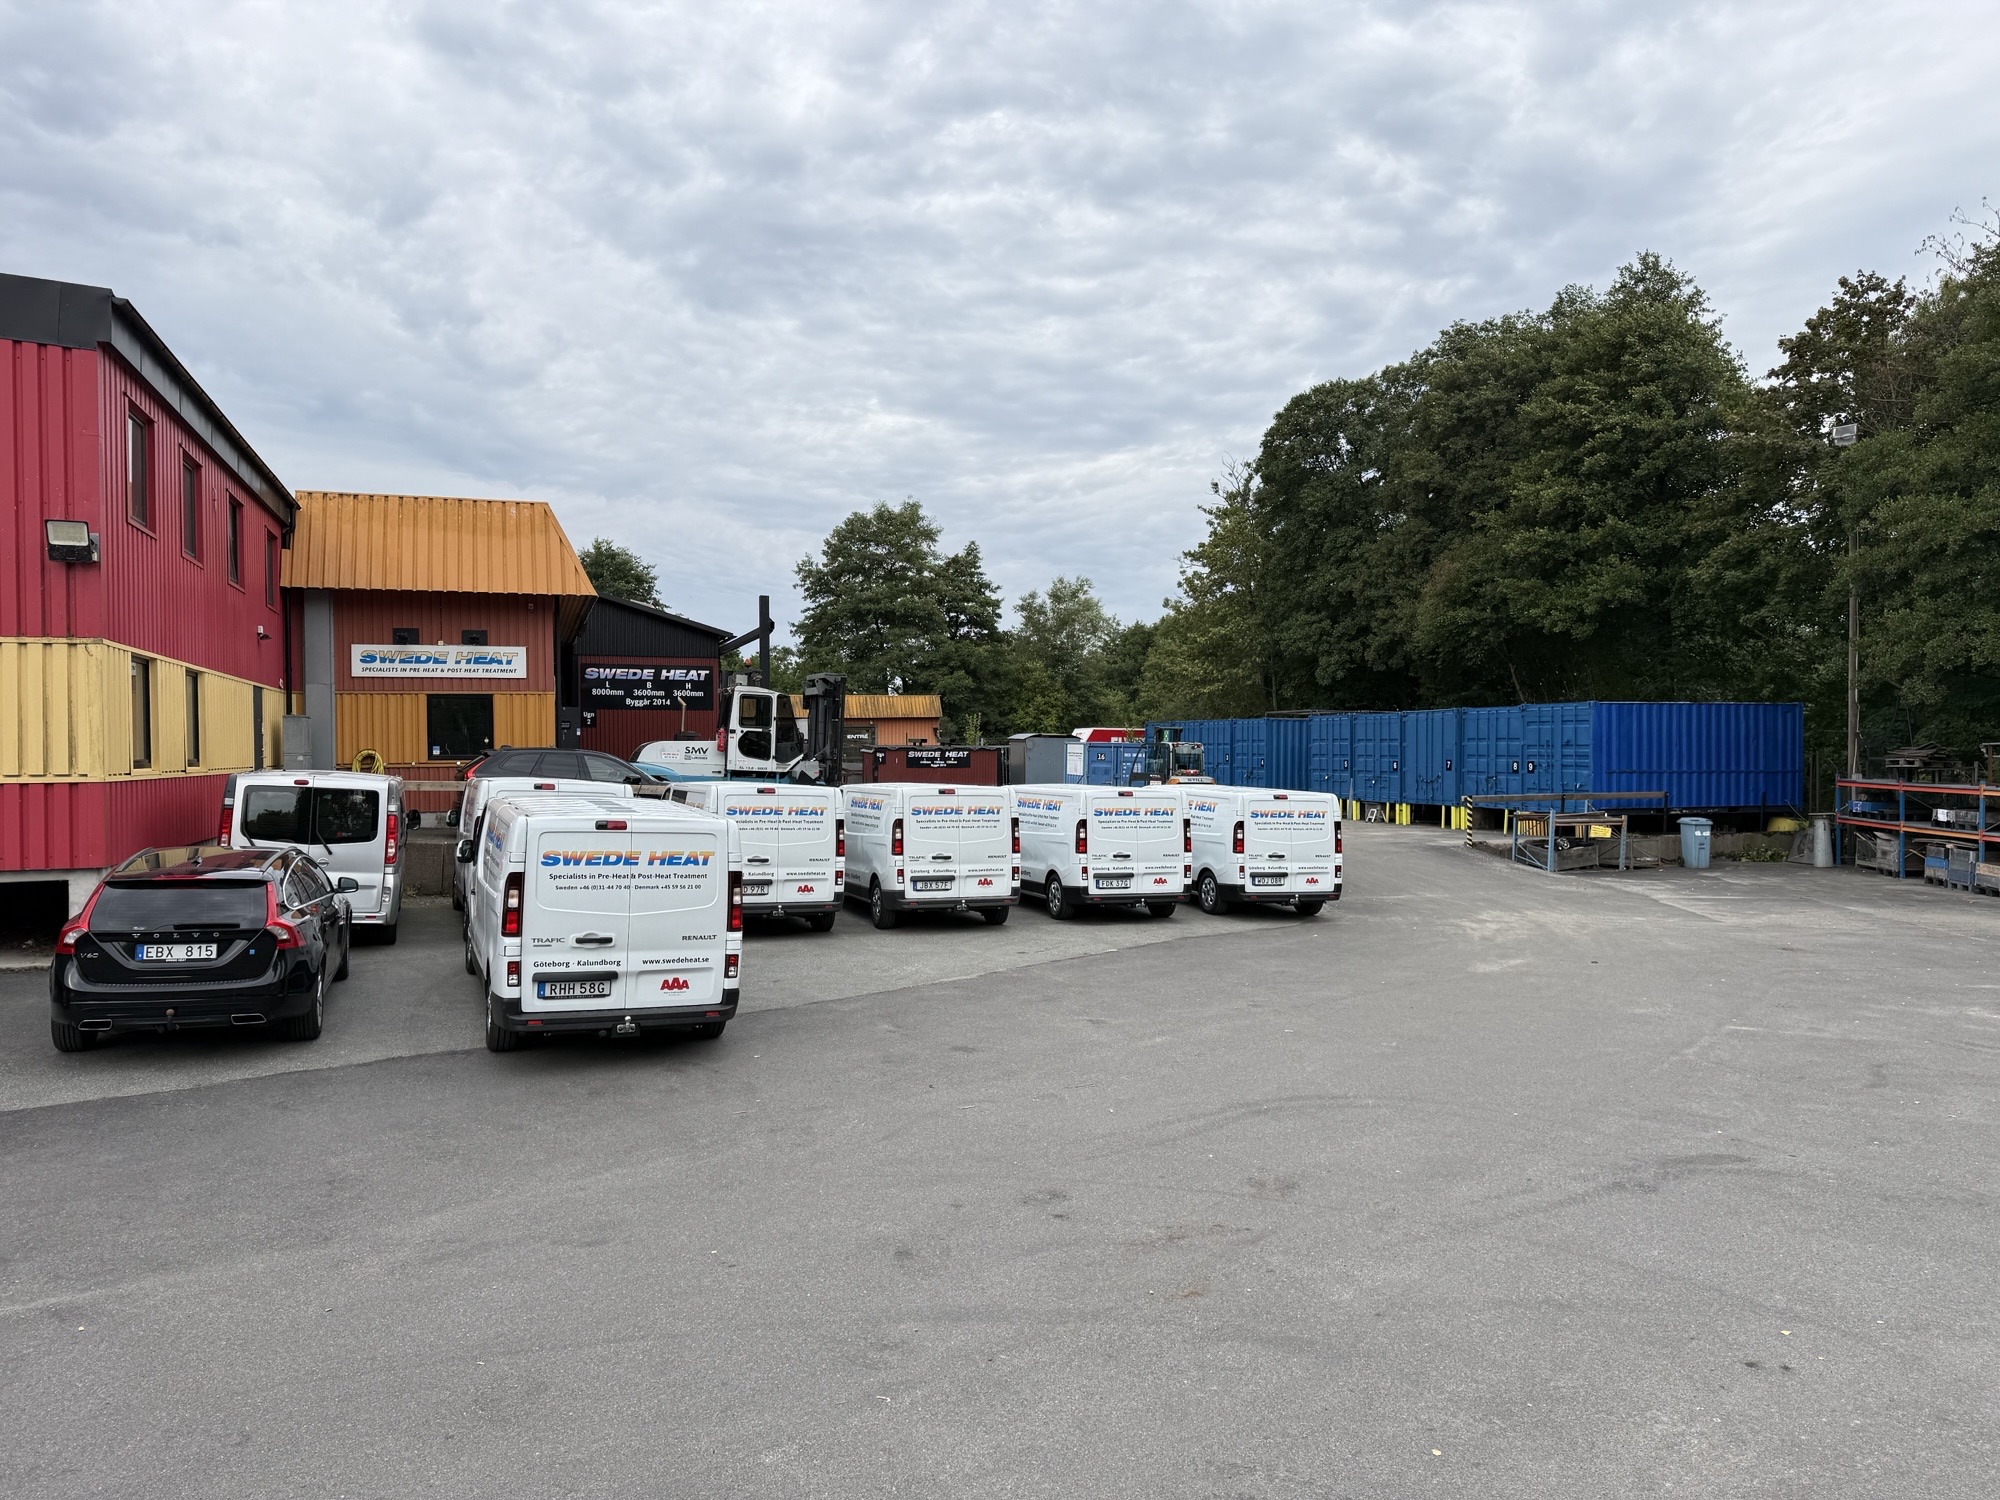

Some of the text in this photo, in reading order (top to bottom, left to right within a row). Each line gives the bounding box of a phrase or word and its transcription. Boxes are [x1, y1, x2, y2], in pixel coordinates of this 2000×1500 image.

[359, 650, 519, 665] SWEDE HEAT
[584, 668, 710, 681] SWEDE HEAT
[592, 688, 624, 696] 8000mm
[626, 698, 671, 707] Byggår 2014
[684, 746, 709, 754] SMV
[1513, 762, 1518, 770] 8
[1528, 762, 1533, 771] 9
[1017, 797, 1064, 811] SWEDE HEAT
[1194, 800, 1218, 812] HEAT
[726, 805, 827, 816] SWEDE HEAT
[911, 806, 1003, 816] SWEDE HEAT
[1093, 807, 1176, 816] SWEDE HEAT
[1250, 809, 1327, 818] SWEDE HEAT
[540, 850, 715, 866] SWEDE HEAT
[977, 877, 993, 886] AAA
[797, 884, 814, 893] AAA
[145, 946, 213, 958] EBX 815
[533, 959, 621, 968] Göteborg Kalundborg
[642, 956, 710, 965] www.swedeheat.se
[550, 982, 605, 995] RHH 58G
[660, 977, 690, 991] AAA
